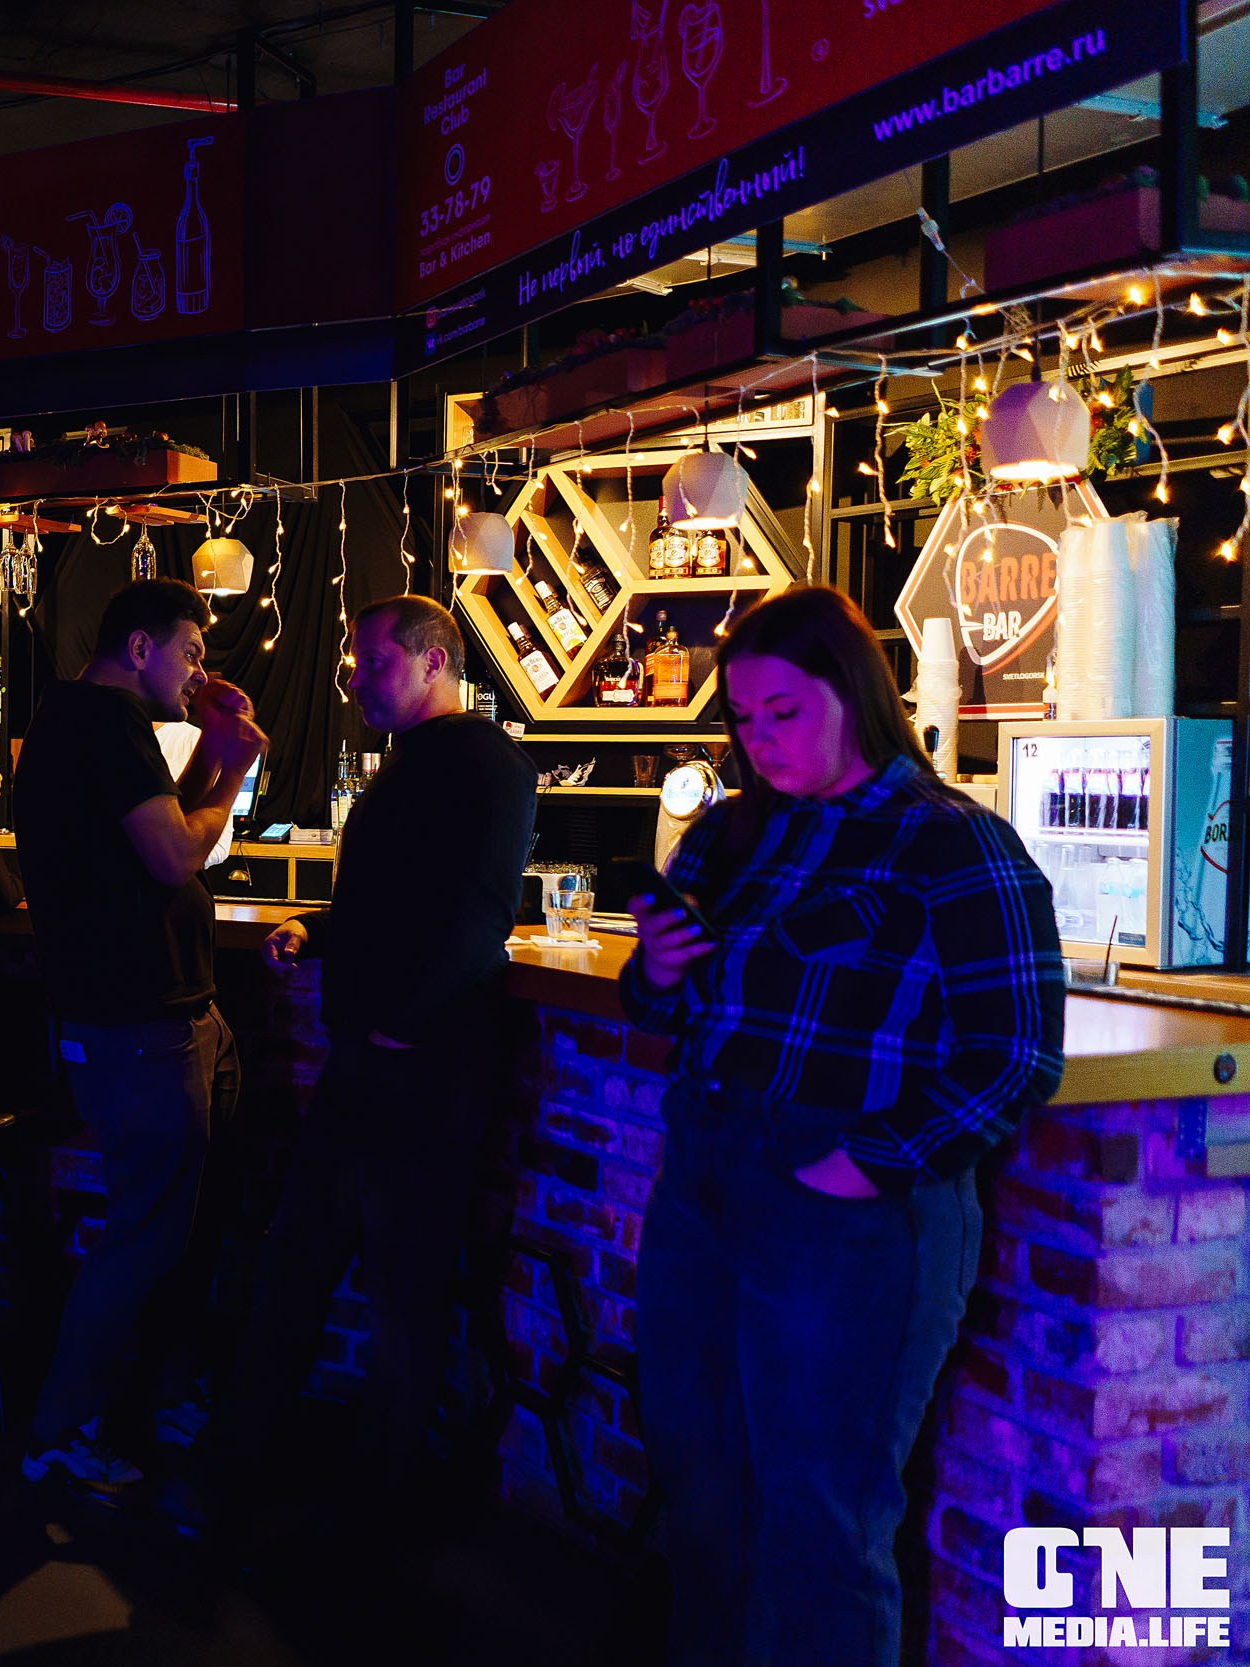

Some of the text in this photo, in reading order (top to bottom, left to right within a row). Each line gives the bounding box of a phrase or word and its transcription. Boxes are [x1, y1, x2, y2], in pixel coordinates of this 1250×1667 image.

[422, 66, 488, 127] Restaurant
[444, 64, 466, 89] Bar
[872, 28, 1107, 142] www.barbarre.ru
[440, 104, 470, 136] Club
[419, 175, 491, 238] 33-78-79
[518, 271, 538, 307] Не
[612, 231, 638, 259] но
[640, 144, 806, 260] единственный!
[419, 260, 437, 279] Bar
[450, 231, 491, 264] Kitchen
[960, 552, 1058, 604] BARRE
[983, 610, 1022, 641] BAR
[1022, 743, 1038, 758] 12
[1204, 823, 1230, 844] BOR
